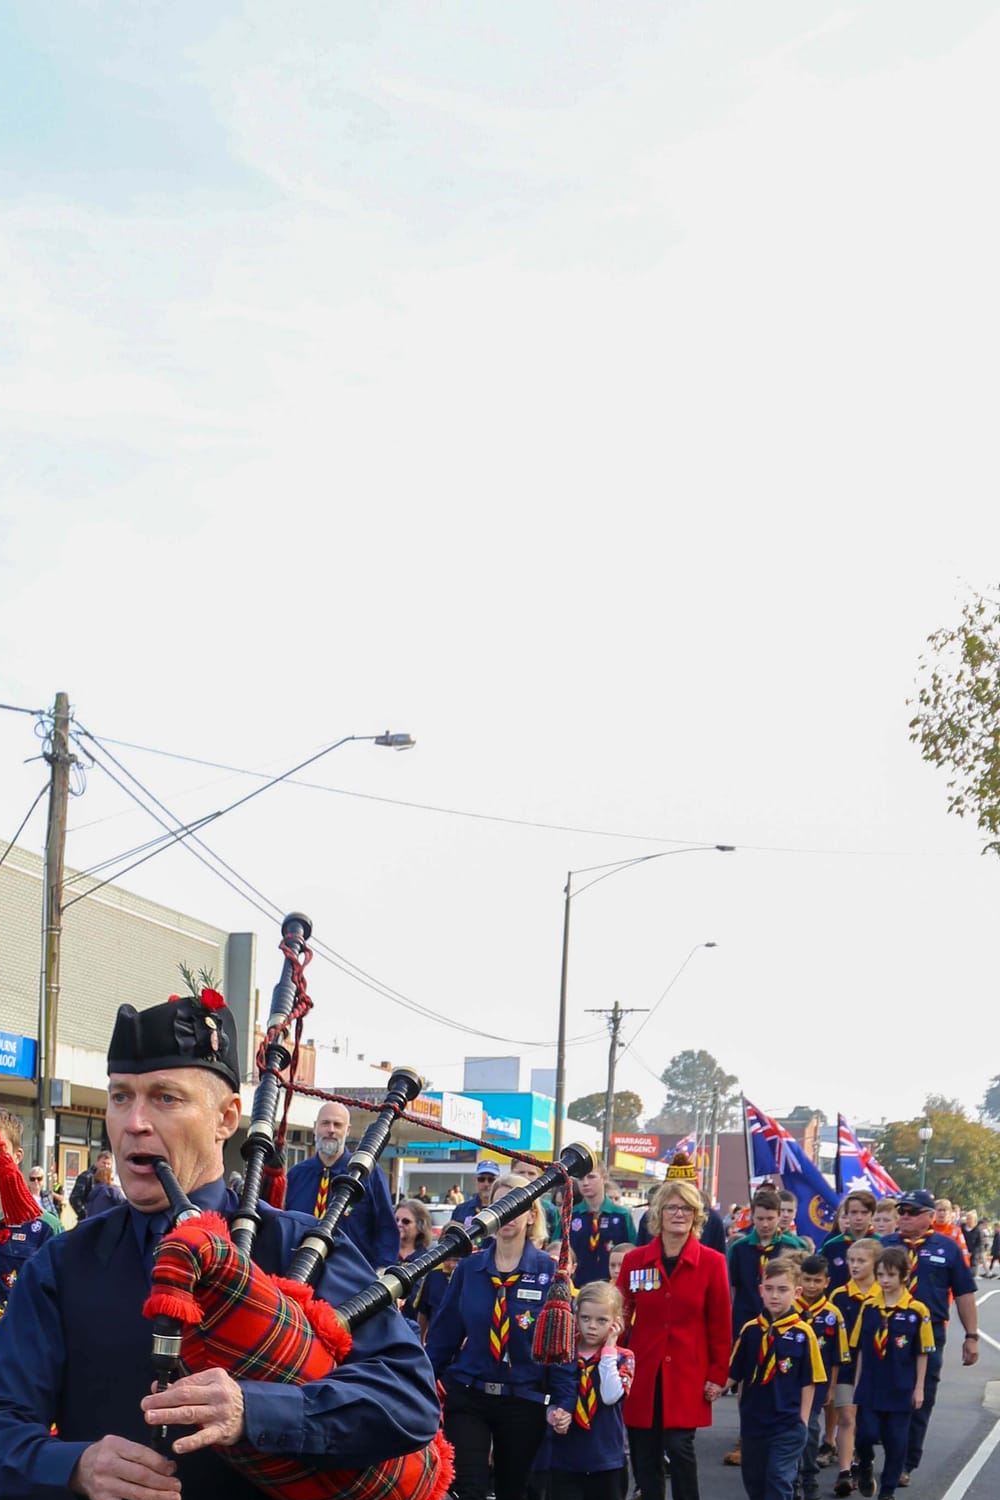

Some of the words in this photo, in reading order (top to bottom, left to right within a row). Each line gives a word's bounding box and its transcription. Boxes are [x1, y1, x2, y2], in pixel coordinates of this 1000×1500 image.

[614, 1136, 653, 1146] WARRAGUL
[395, 1147, 436, 1157] Desire
[616, 1145, 657, 1154] WSAGENCY
